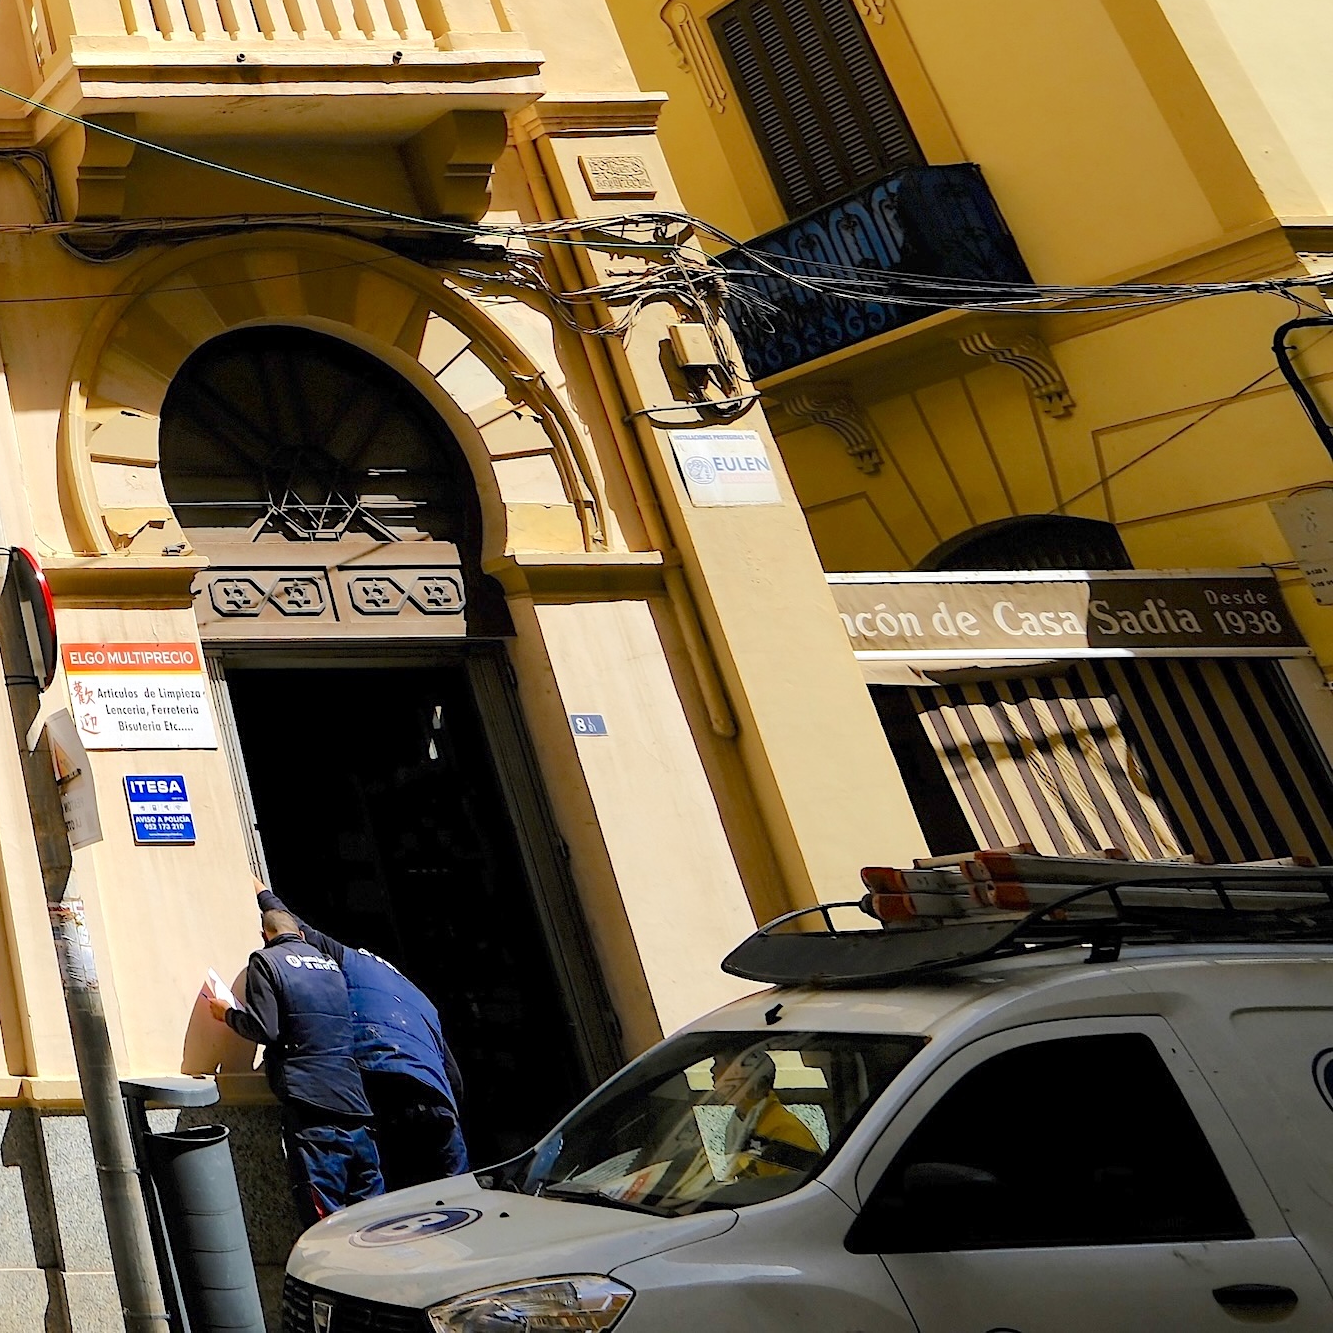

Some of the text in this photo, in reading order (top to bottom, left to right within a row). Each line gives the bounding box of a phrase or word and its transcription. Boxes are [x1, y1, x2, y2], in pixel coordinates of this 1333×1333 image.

[712, 457, 770, 471] EULEN
[1204, 589, 1269, 605] Desde
[839, 598, 1203, 637] ncón de Casa Sadia
[1213, 610, 1283, 635] 1938
[69, 651, 194, 665] ELGO MULTIPRECIO
[144, 687, 156, 698] de
[575, 717, 587, 732] 8
[130, 780, 182, 794] ITESA
[164, 815, 191, 823] POLICÍA
